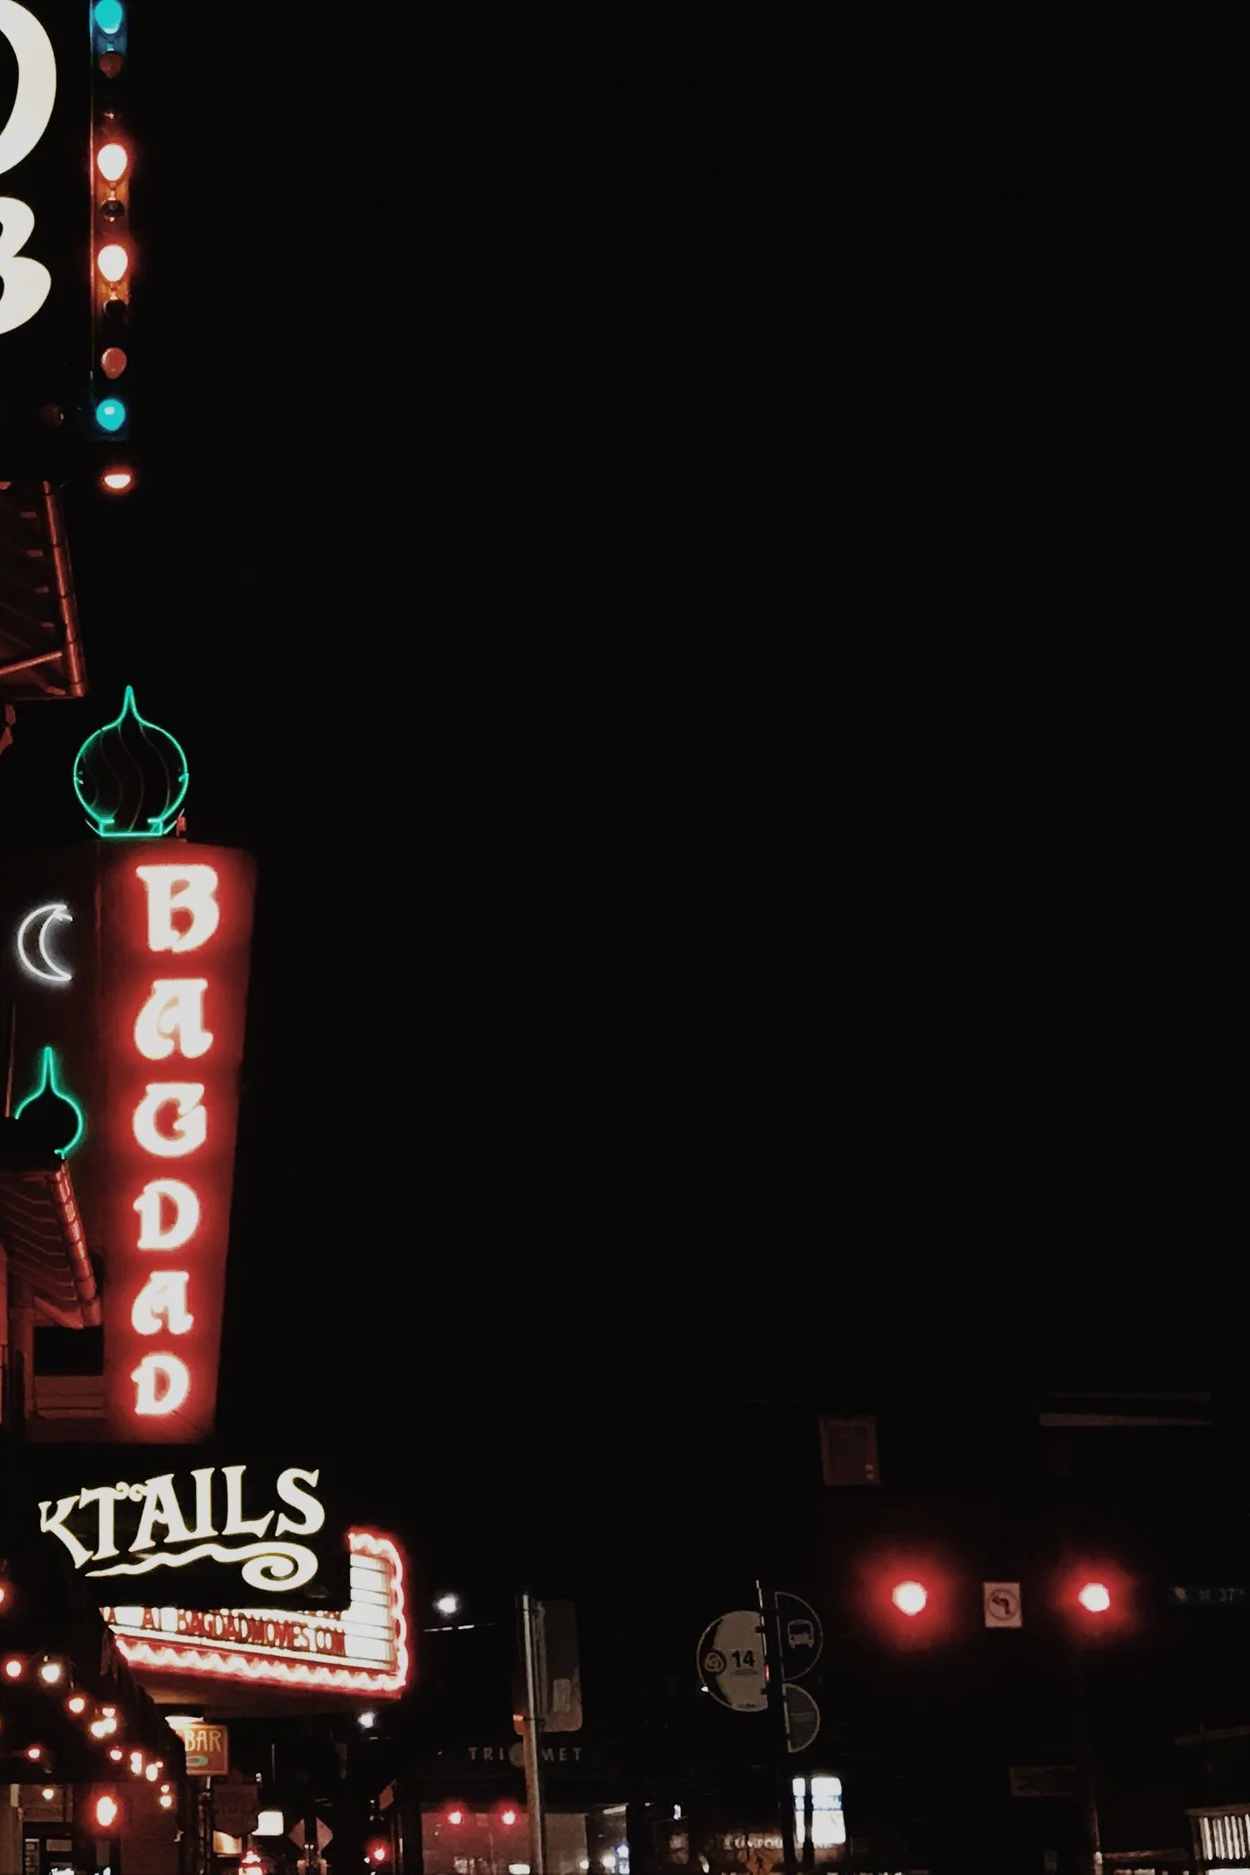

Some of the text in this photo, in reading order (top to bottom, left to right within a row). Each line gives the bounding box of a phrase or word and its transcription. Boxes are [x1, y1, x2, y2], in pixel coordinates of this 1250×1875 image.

[131, 863, 220, 1416] BAGDAD
[730, 1649, 756, 1668] 14
[185, 1729, 222, 1753] BAR
[467, 1745, 583, 1763] TRI MET
